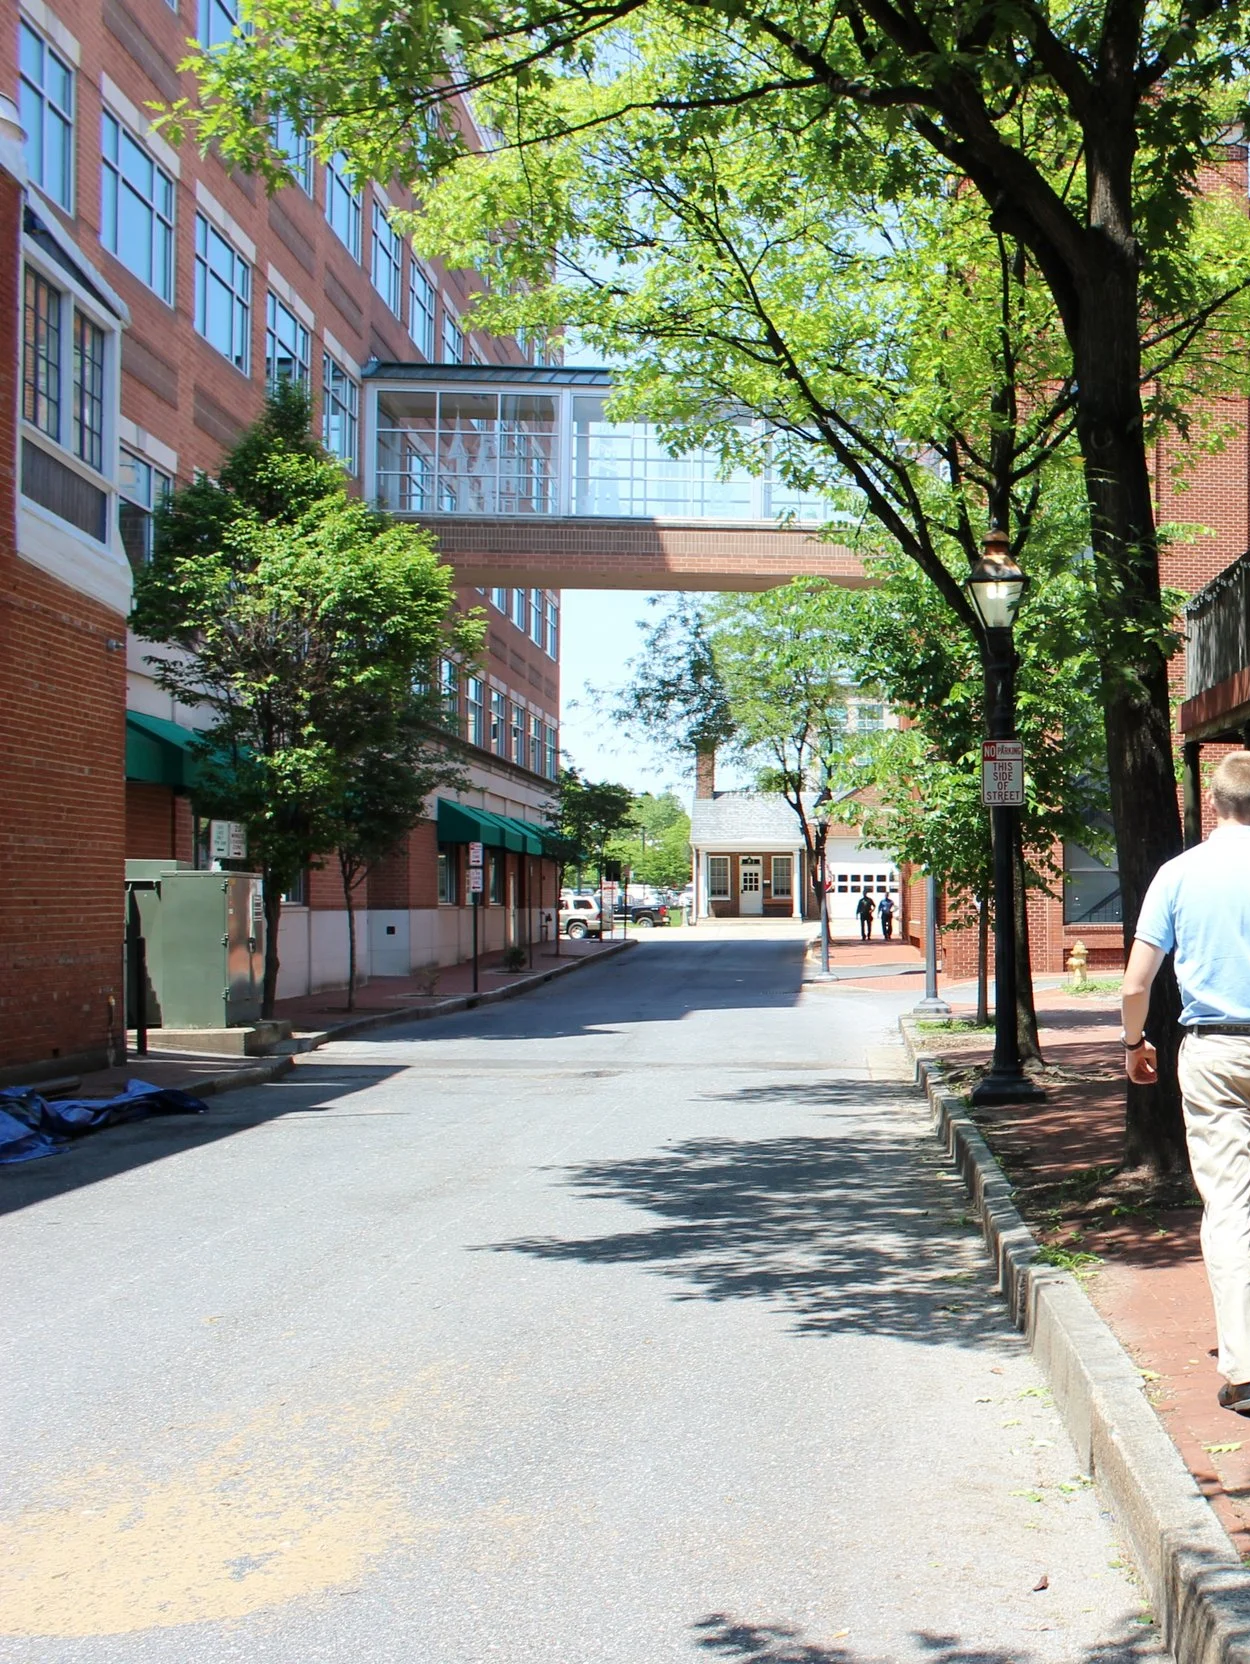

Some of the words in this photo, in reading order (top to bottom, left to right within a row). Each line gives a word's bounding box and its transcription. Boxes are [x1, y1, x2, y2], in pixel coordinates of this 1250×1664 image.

[984, 746, 996, 757] NO
[998, 746, 1021, 754] PARKING
[993, 762, 1013, 771] THIS
[993, 772, 1013, 781] SIDE
[997, 782, 1009, 790] OF
[986, 791, 1020, 800] STREET
